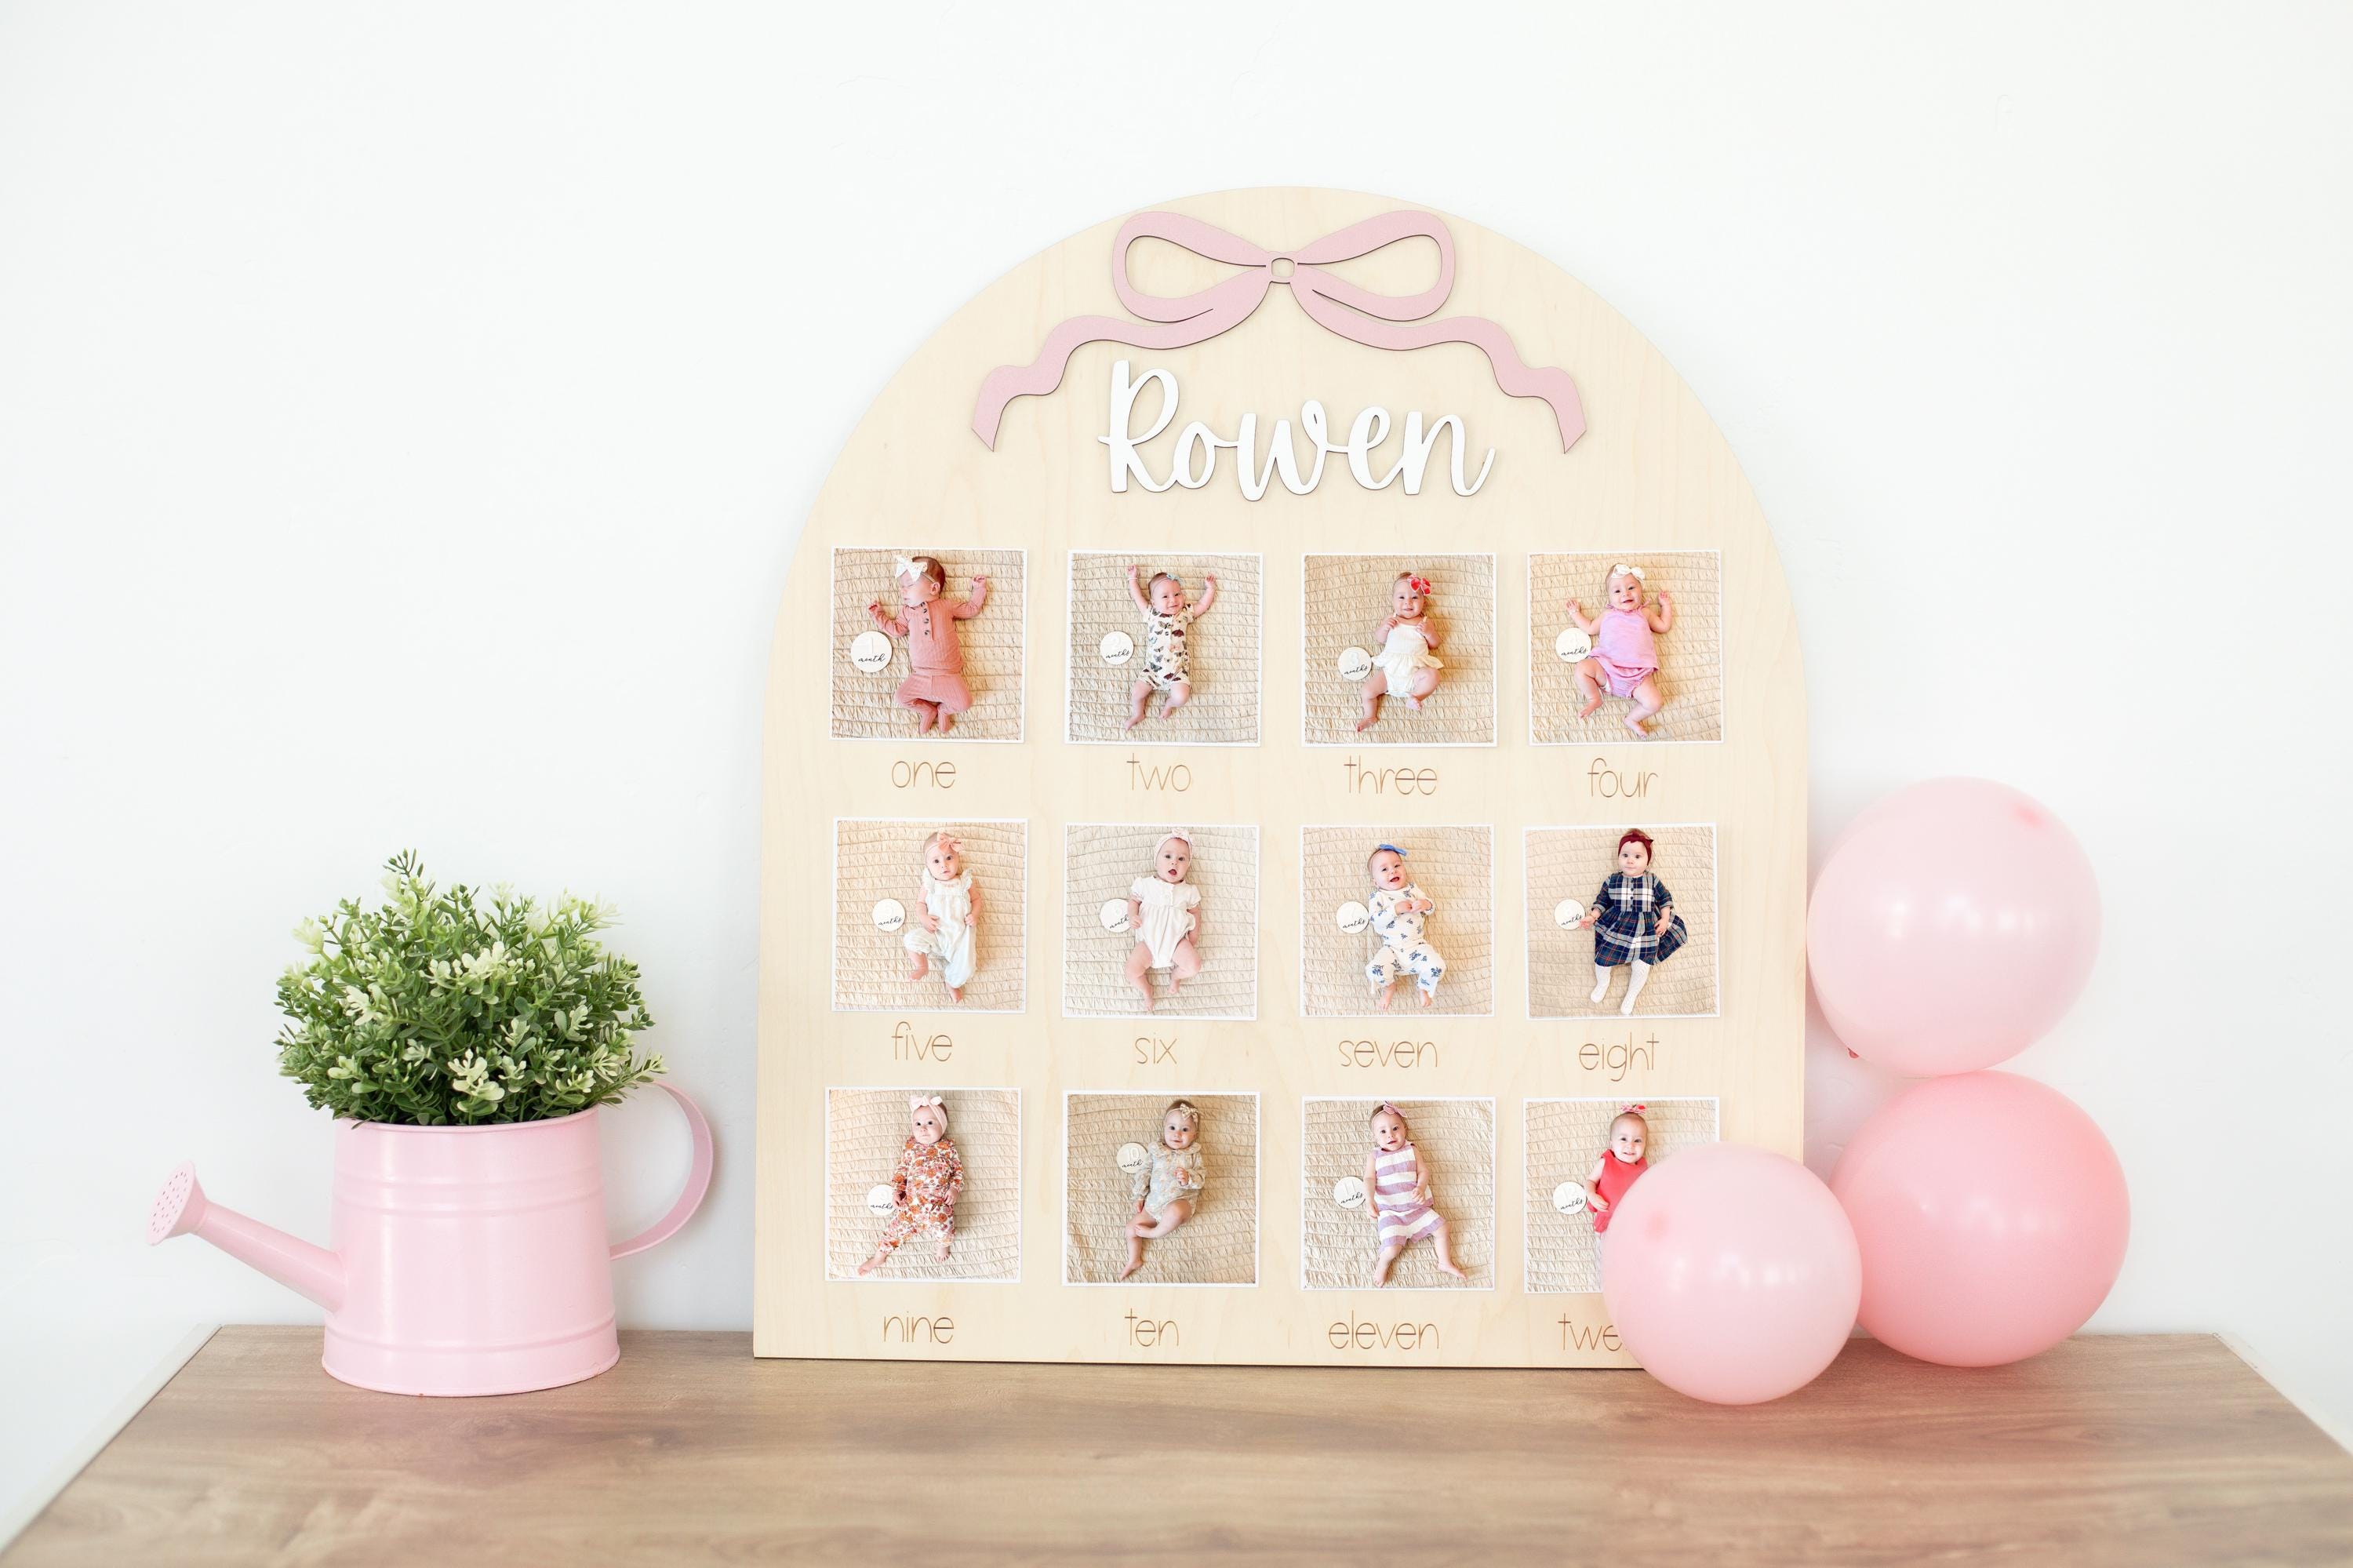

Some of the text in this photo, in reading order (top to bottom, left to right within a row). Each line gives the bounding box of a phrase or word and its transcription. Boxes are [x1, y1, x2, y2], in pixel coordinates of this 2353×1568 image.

[1097, 359, 1496, 502] Rowen
[858, 653, 886, 663] month
[1105, 649, 1131, 659] months
[1561, 646, 1587, 657] months
[1344, 664, 1368, 675] months
[892, 761, 956, 788] one
[1126, 753, 1191, 791] two
[1344, 755, 1437, 795] three
[1587, 758, 1659, 799] four
[878, 915, 904, 926] months
[1109, 915, 1128, 929] month
[1342, 917, 1366, 929] months
[1561, 913, 1582, 926] months
[891, 1021, 952, 1062] five
[1134, 1033, 1177, 1064] six
[1339, 1040, 1438, 1068] seven
[1579, 1032, 1659, 1082] eight
[1122, 1159, 1144, 1168] month
[870, 1202, 894, 1210] months
[1340, 1191, 1363, 1204] months
[1560, 1197, 1584, 1210] months
[884, 1312, 954, 1344] nine
[1125, 1308, 1180, 1348] ten
[1329, 1310, 1438, 1351] eleven
[1558, 1313, 1623, 1352] twe
